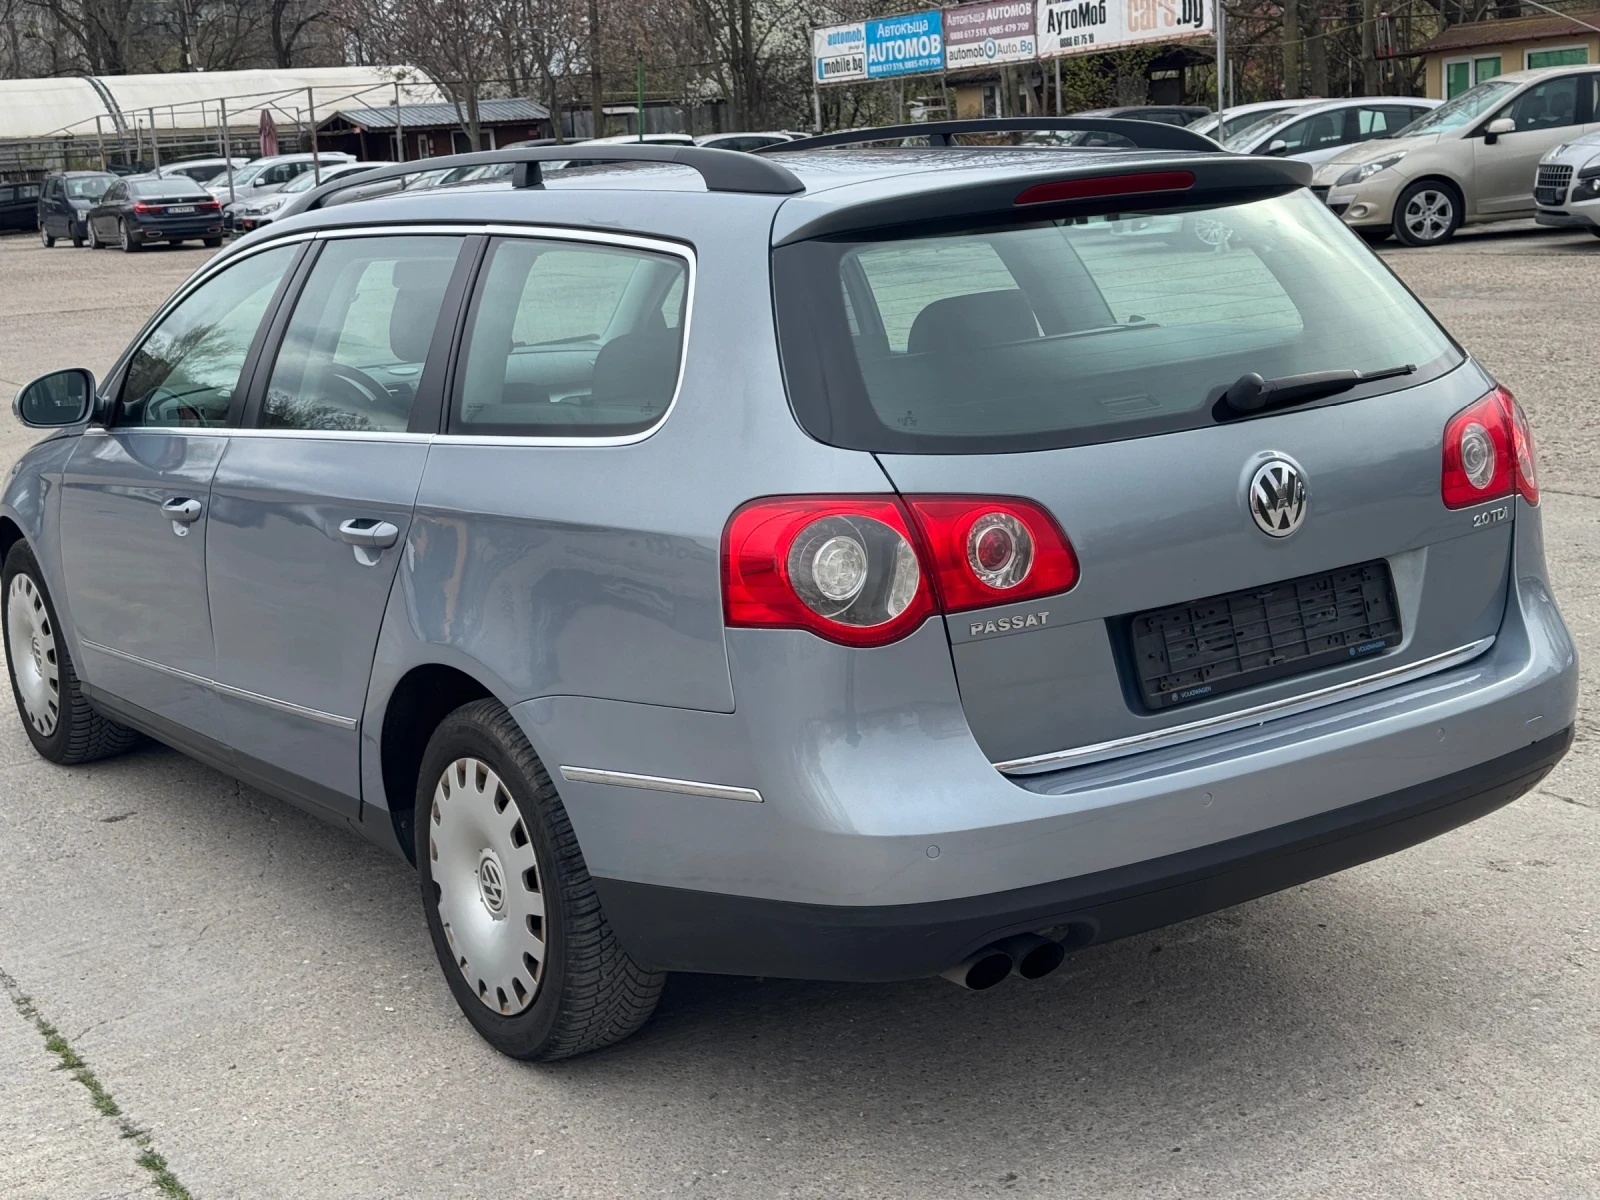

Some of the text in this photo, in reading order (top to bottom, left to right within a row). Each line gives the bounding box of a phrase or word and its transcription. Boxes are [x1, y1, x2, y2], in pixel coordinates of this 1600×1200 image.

[947, 3, 1032, 27] Автокъща AUTOMOB
[1047, 0, 1106, 36] АутоМоб
[876, 19, 929, 39] Автокъща
[868, 33, 942, 64] AUTOMOB
[948, 40, 1033, 61] automob Auto.Bg
[823, 56, 863, 75] mobile.bg
[970, 611, 1050, 636] PASSAT
